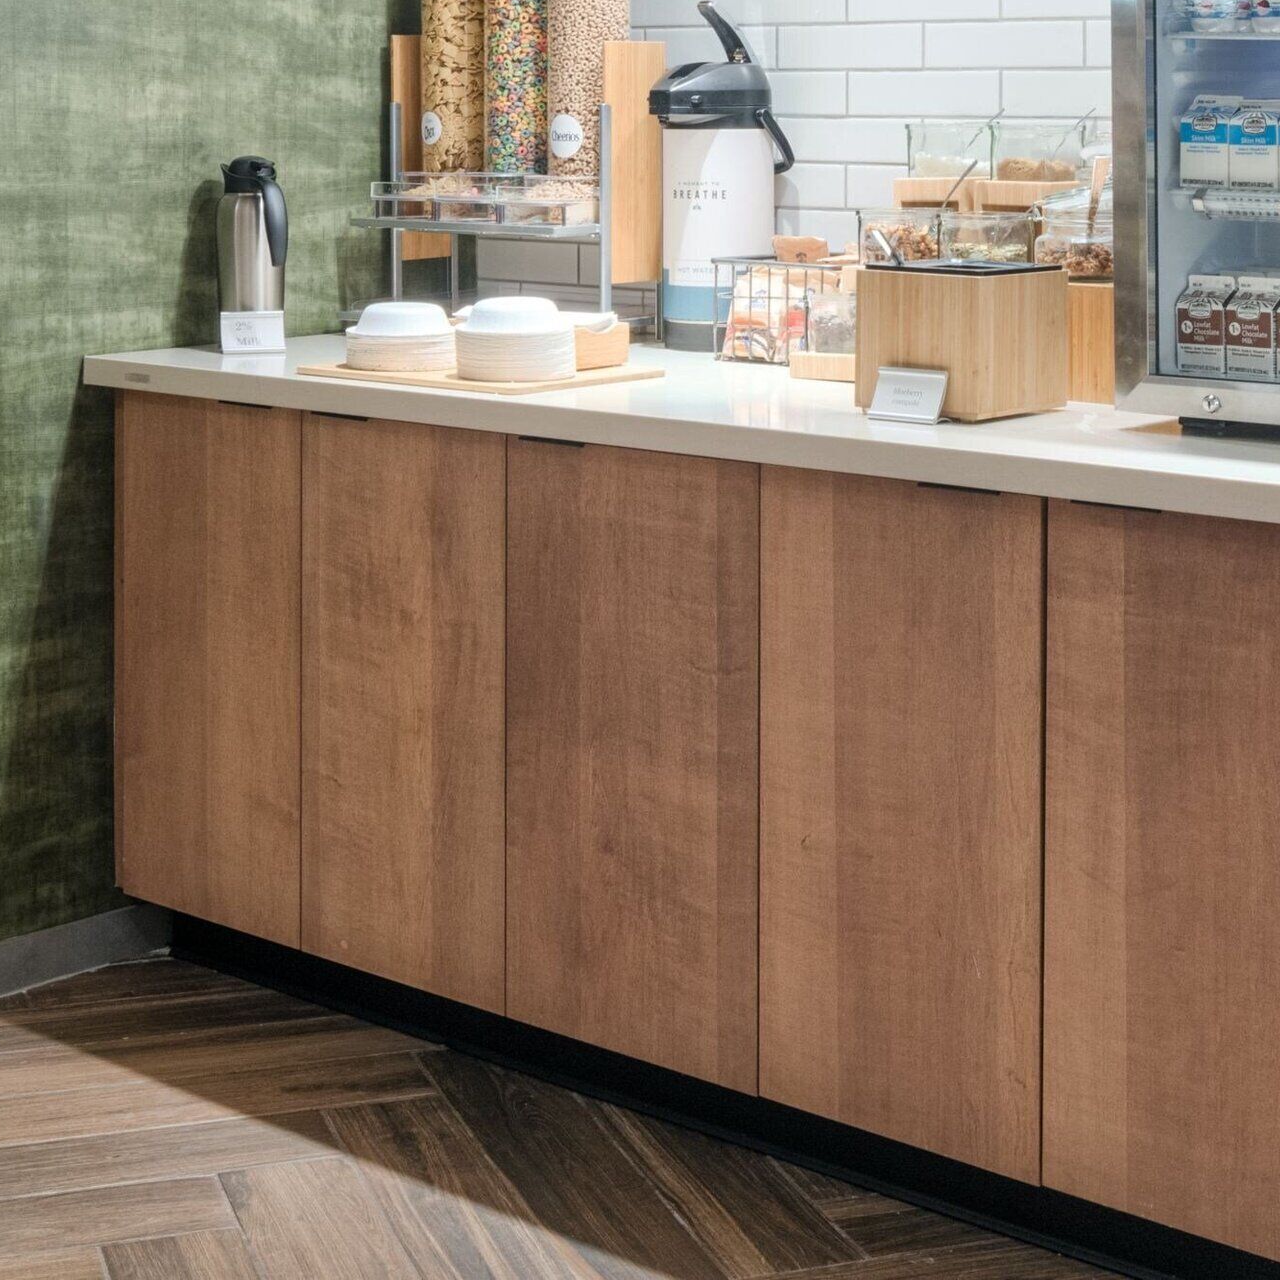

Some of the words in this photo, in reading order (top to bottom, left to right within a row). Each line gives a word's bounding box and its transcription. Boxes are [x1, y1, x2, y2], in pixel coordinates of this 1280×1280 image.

[673, 189, 727, 199] BREATHE
[1194, 328, 1219, 336] Chocolate
[1241, 330, 1268, 338] Chocolate
